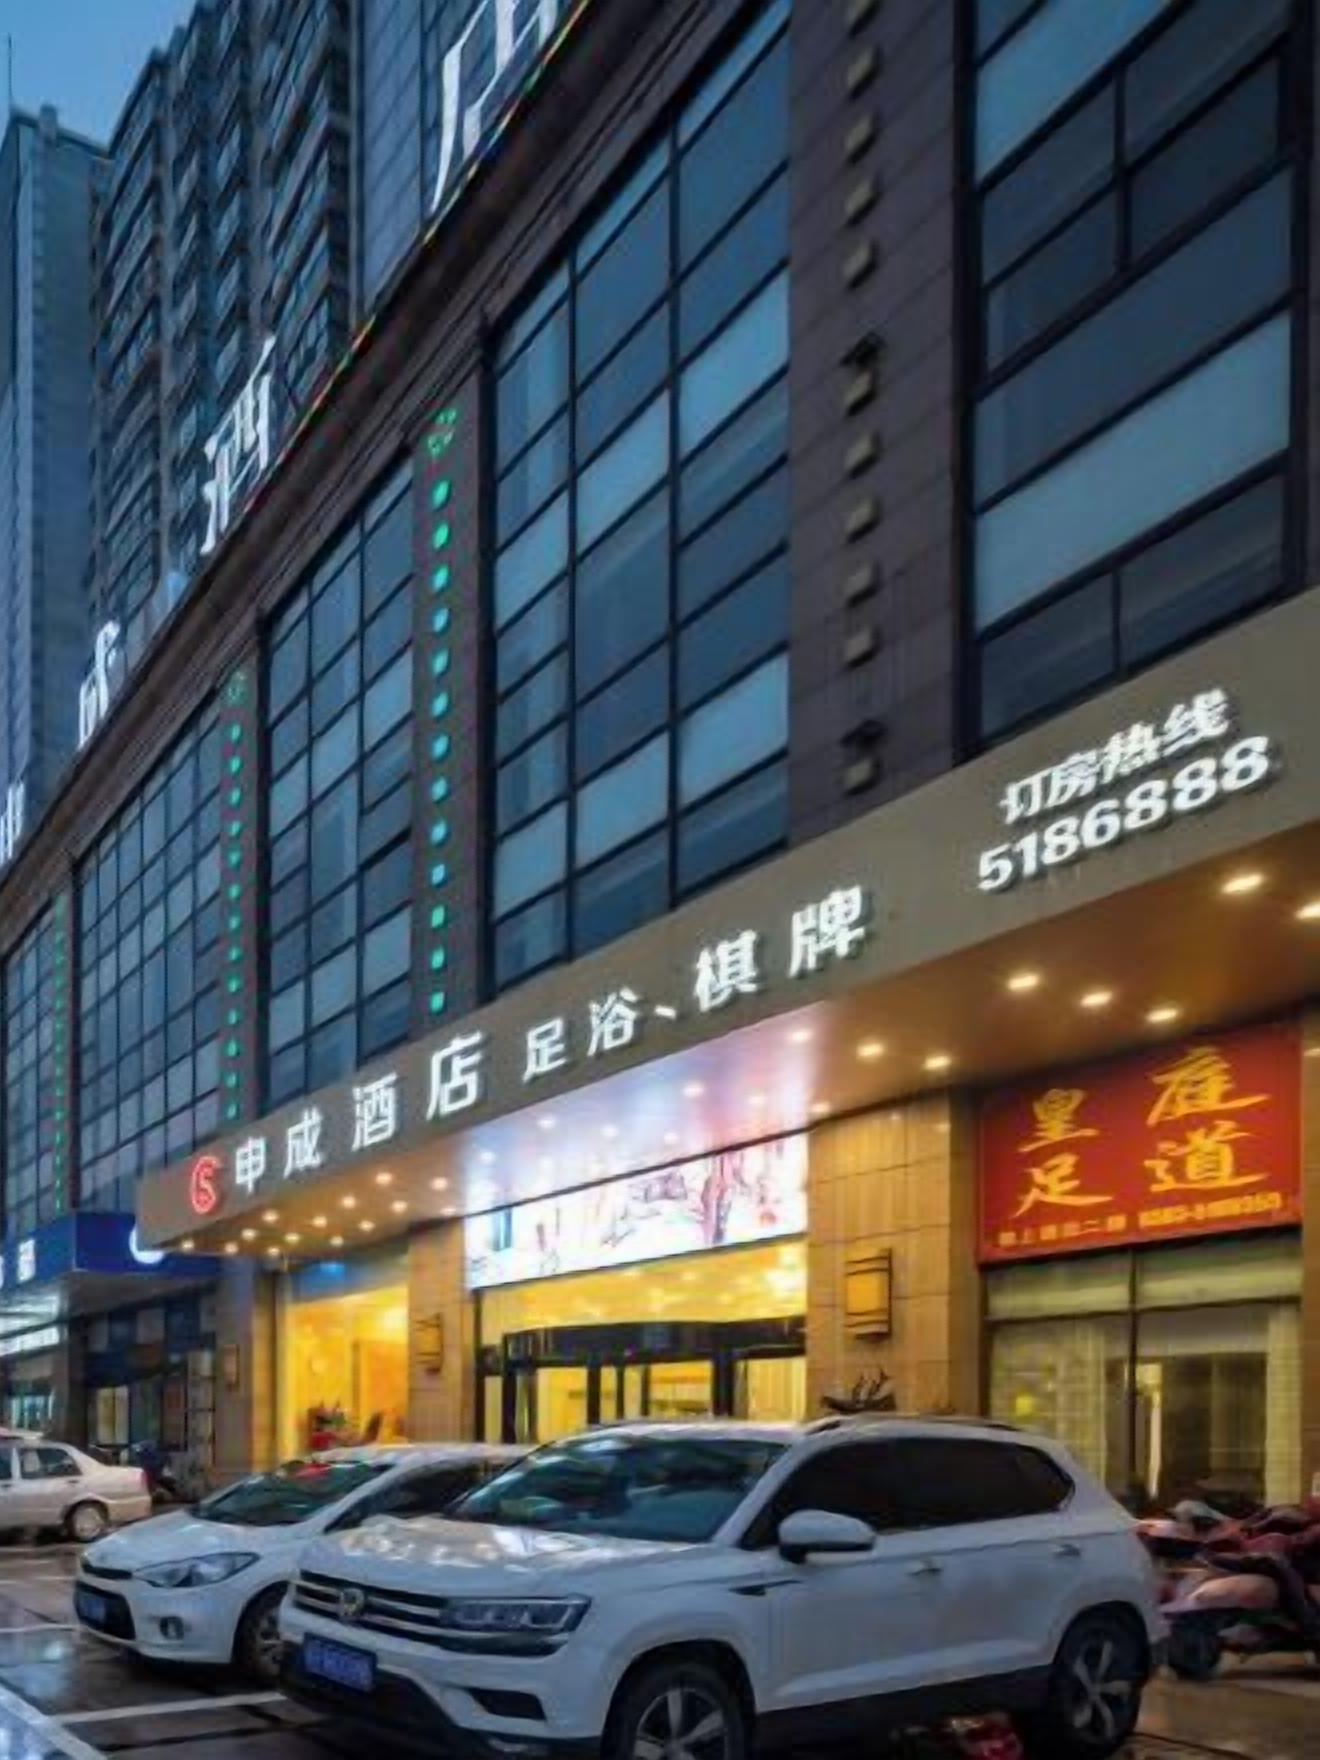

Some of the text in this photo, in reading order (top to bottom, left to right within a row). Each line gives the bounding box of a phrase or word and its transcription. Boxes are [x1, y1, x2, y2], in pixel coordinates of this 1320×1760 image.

[978, 736, 1271, 893] 5186888
[998, 688, 1231, 826] 订房热线
[234, 1033, 481, 1194] 申成酒店
